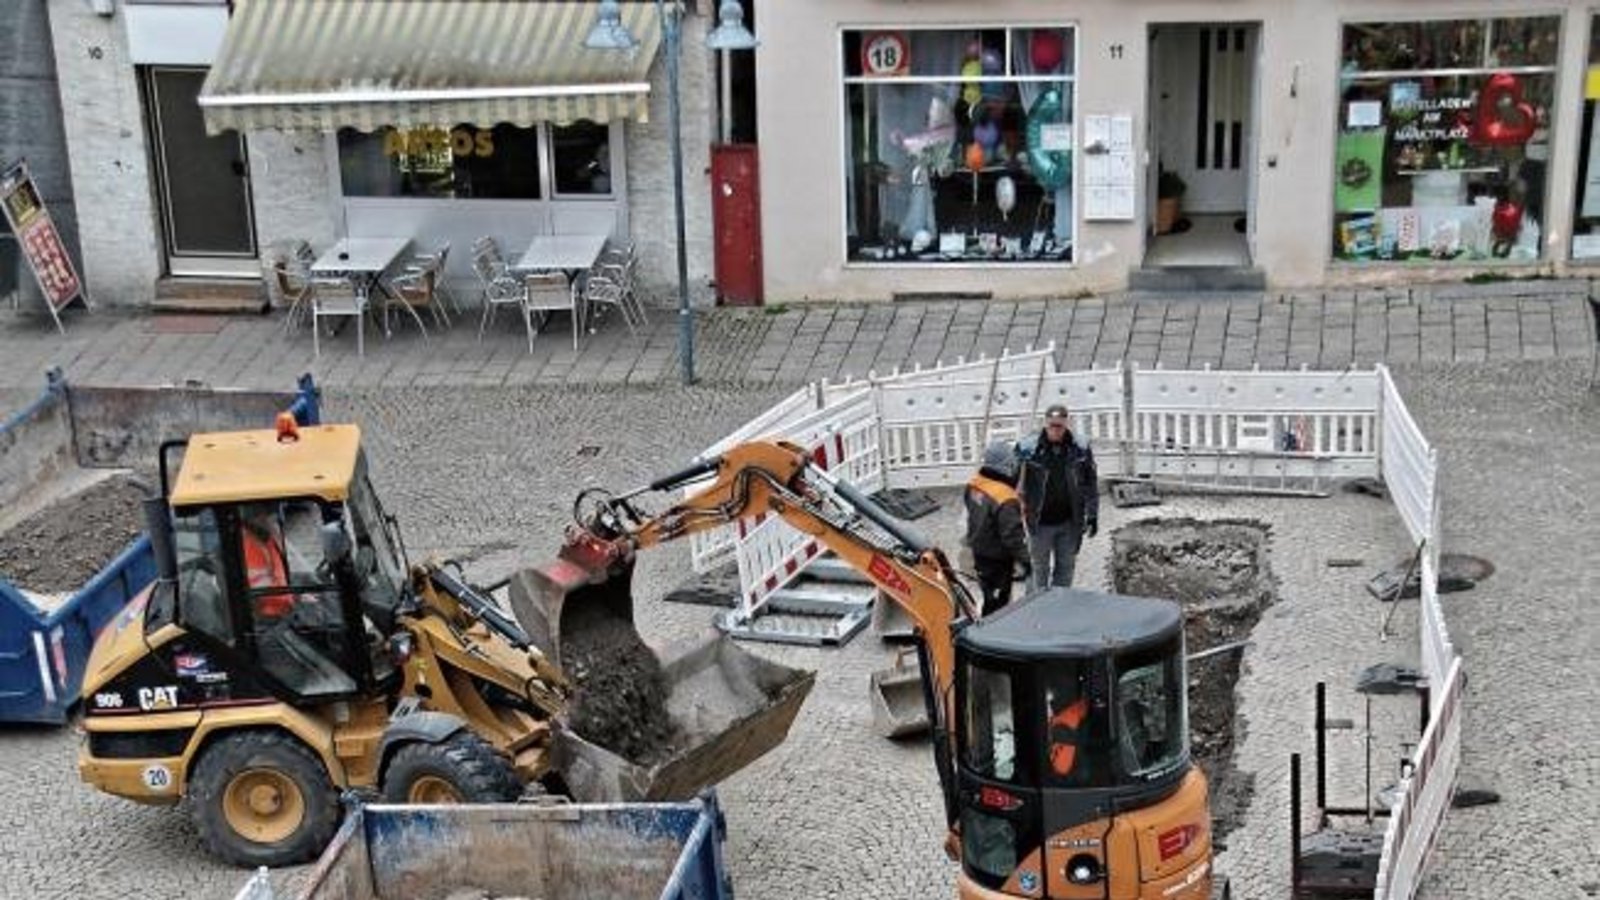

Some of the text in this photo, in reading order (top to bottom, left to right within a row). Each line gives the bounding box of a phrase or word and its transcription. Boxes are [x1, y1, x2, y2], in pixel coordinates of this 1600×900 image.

[88, 46, 103, 60] 10
[871, 46, 897, 69] 18
[1109, 44, 1123, 60] 11
[1393, 98, 1471, 111] ASTELLADEN
[138, 686, 178, 710] CAT
[148, 769, 168, 786] 20
